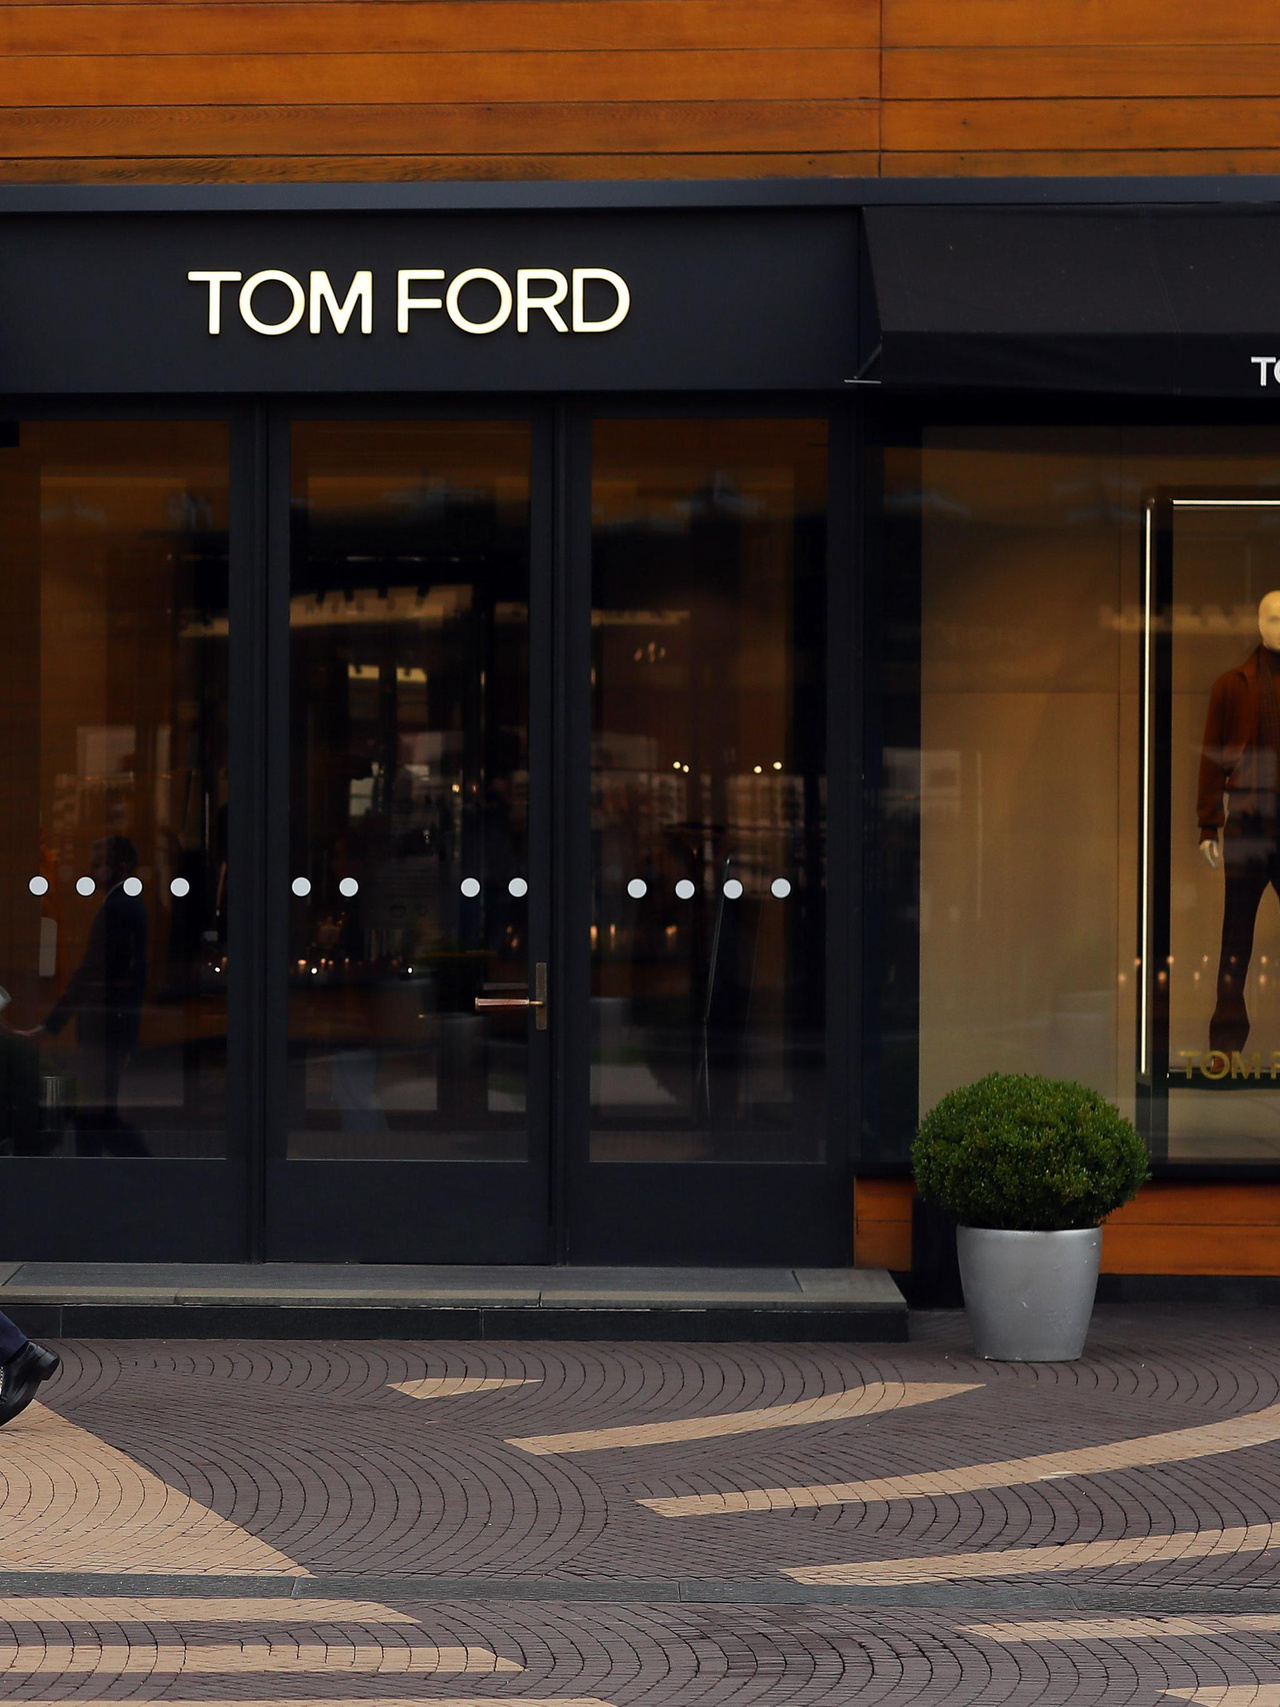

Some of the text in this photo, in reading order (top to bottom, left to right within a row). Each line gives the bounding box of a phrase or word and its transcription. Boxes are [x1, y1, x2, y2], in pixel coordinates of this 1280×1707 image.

[187, 267, 631, 335] TOM FORD
[1250, 356, 1280, 387] T
[1177, 1050, 1261, 1080] TOM
